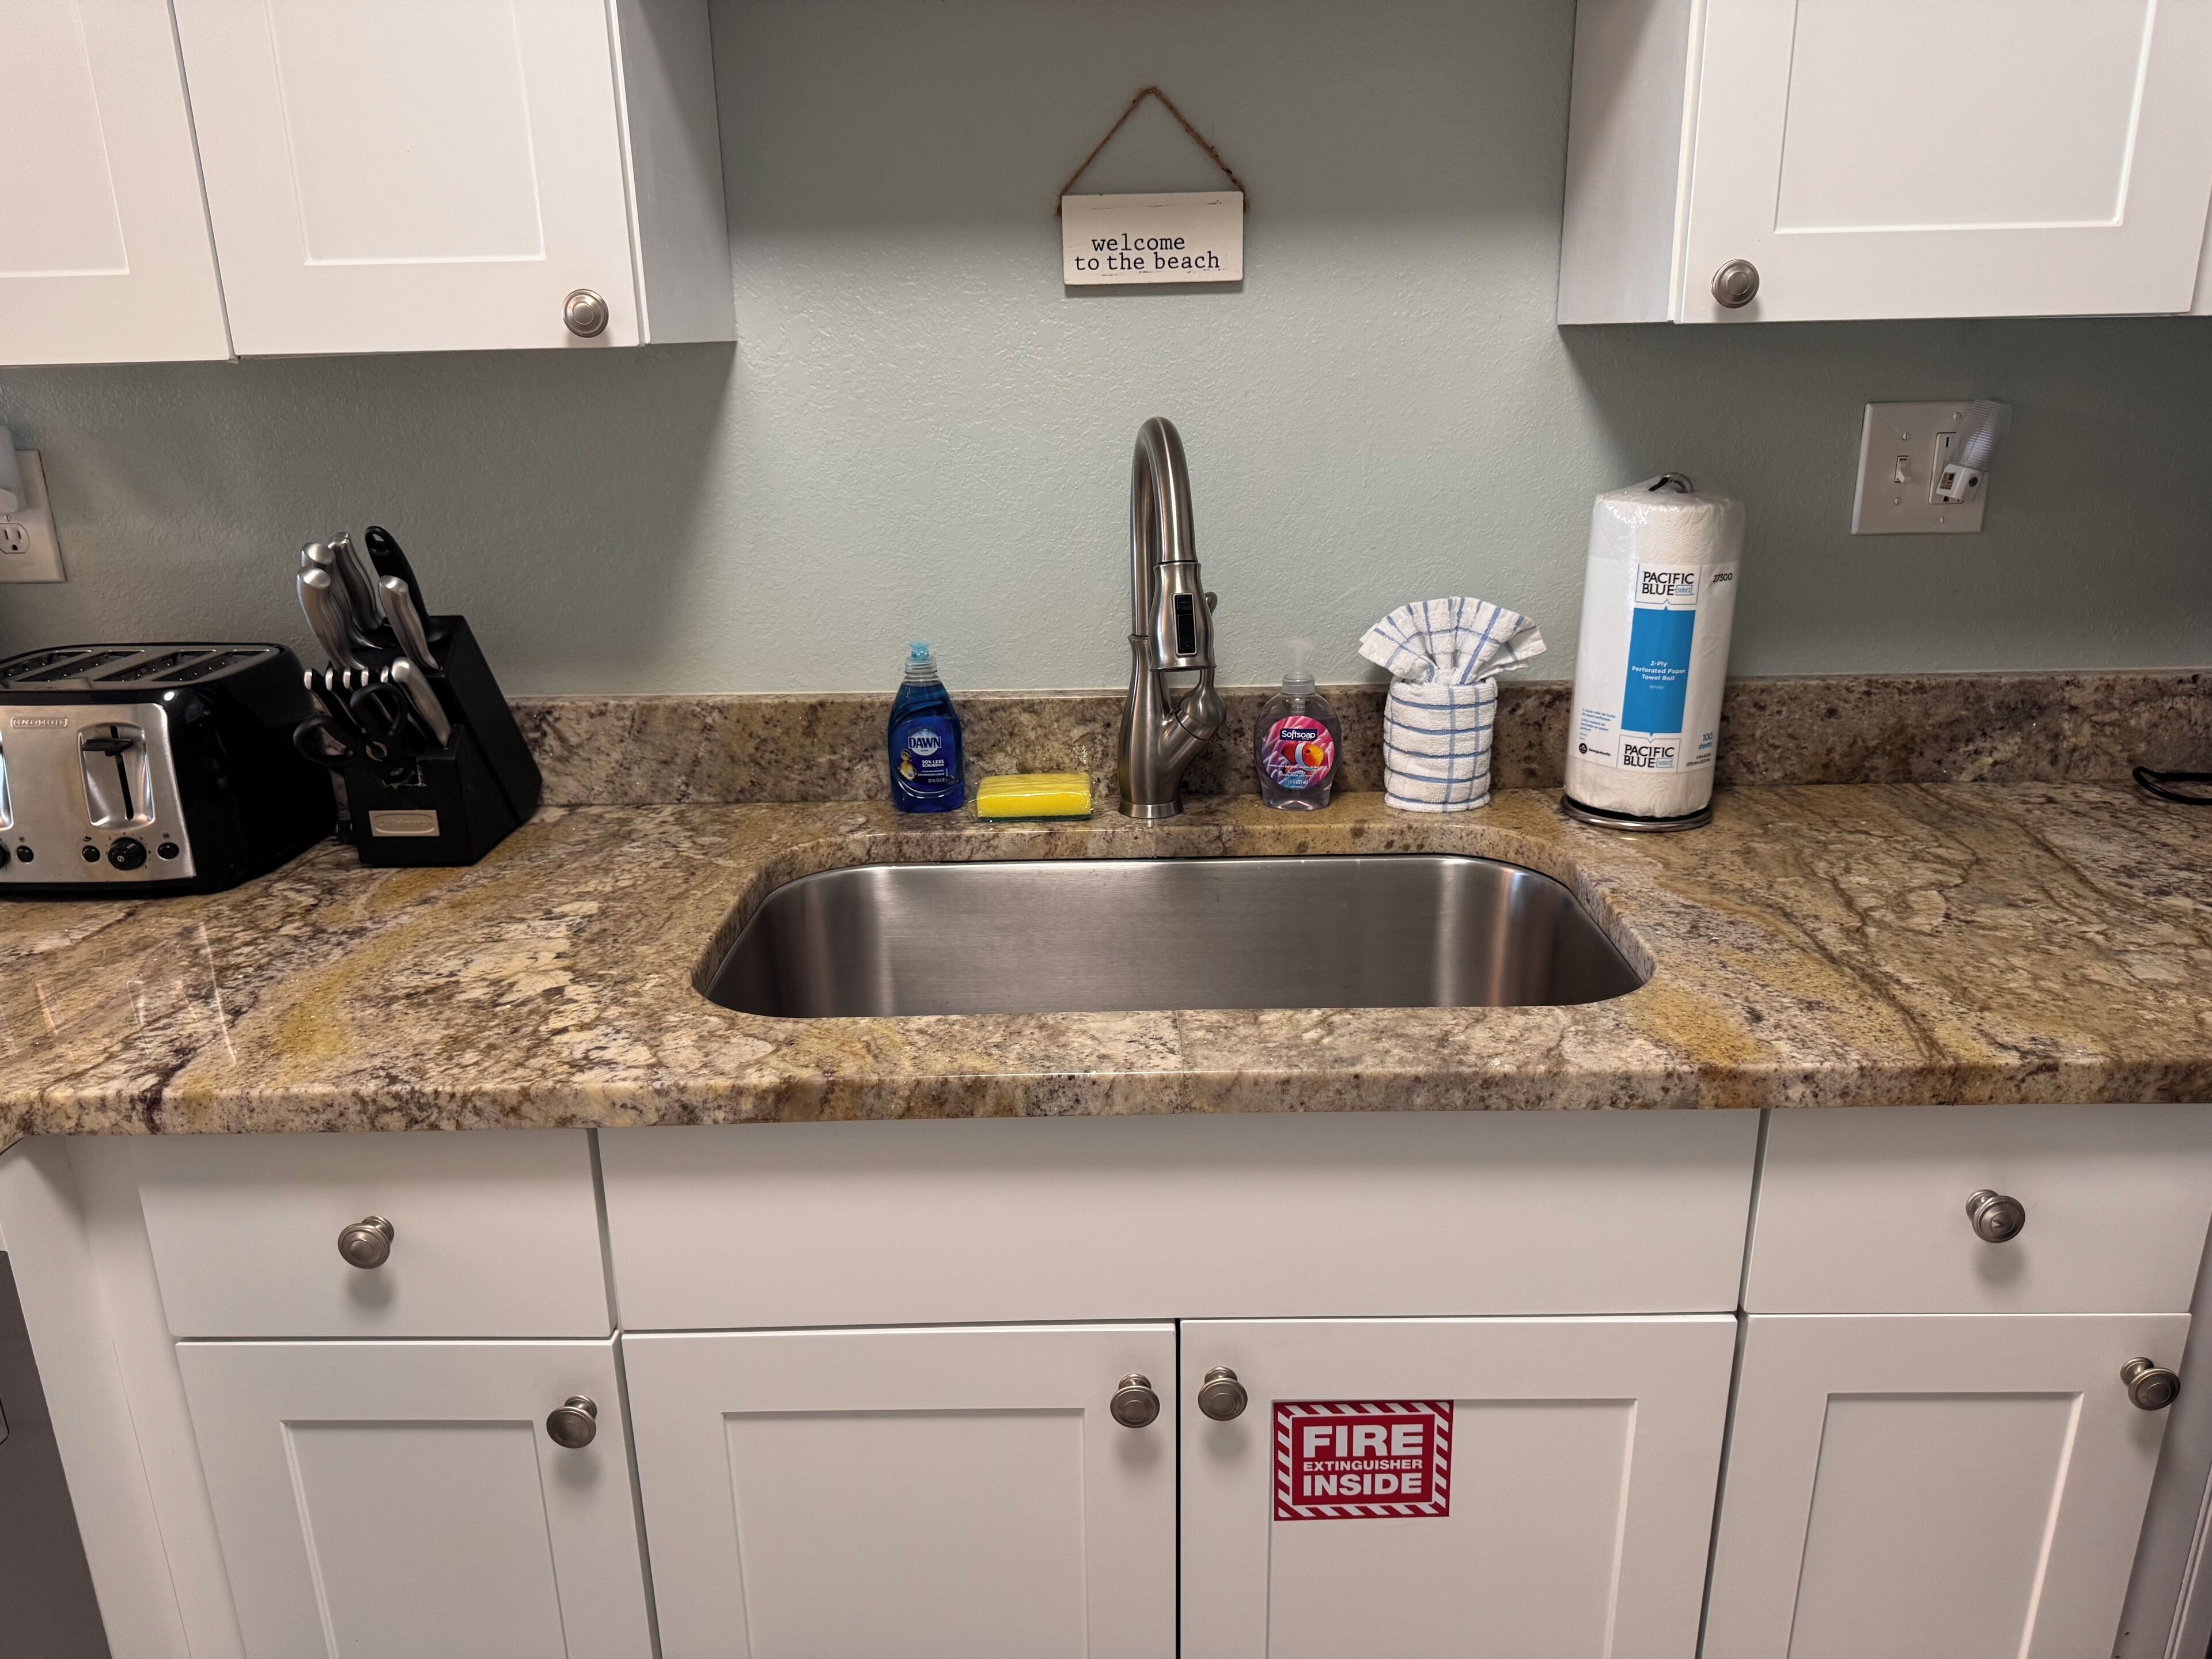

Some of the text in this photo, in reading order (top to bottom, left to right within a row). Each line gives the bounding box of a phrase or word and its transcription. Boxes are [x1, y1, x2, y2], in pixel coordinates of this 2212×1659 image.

[1092, 233, 1185, 251] welcome
[1075, 251, 1220, 271] to the beach
[1643, 571, 1694, 584] PACIFIC
[1713, 573, 1733, 582] 27300
[1642, 583, 1675, 596] BLUE
[1281, 730, 1316, 739] Softsoap
[1703, 732, 1713, 741] 100
[908, 737, 941, 748] DAWN
[1624, 744, 1675, 757] PACIFIC
[1623, 755, 1655, 768] BLUE
[1303, 1423, 1424, 1458] FIRE
[1303, 1459, 1423, 1471] EXTINGUISHER
[1303, 1472, 1422, 1497] INSIDE
